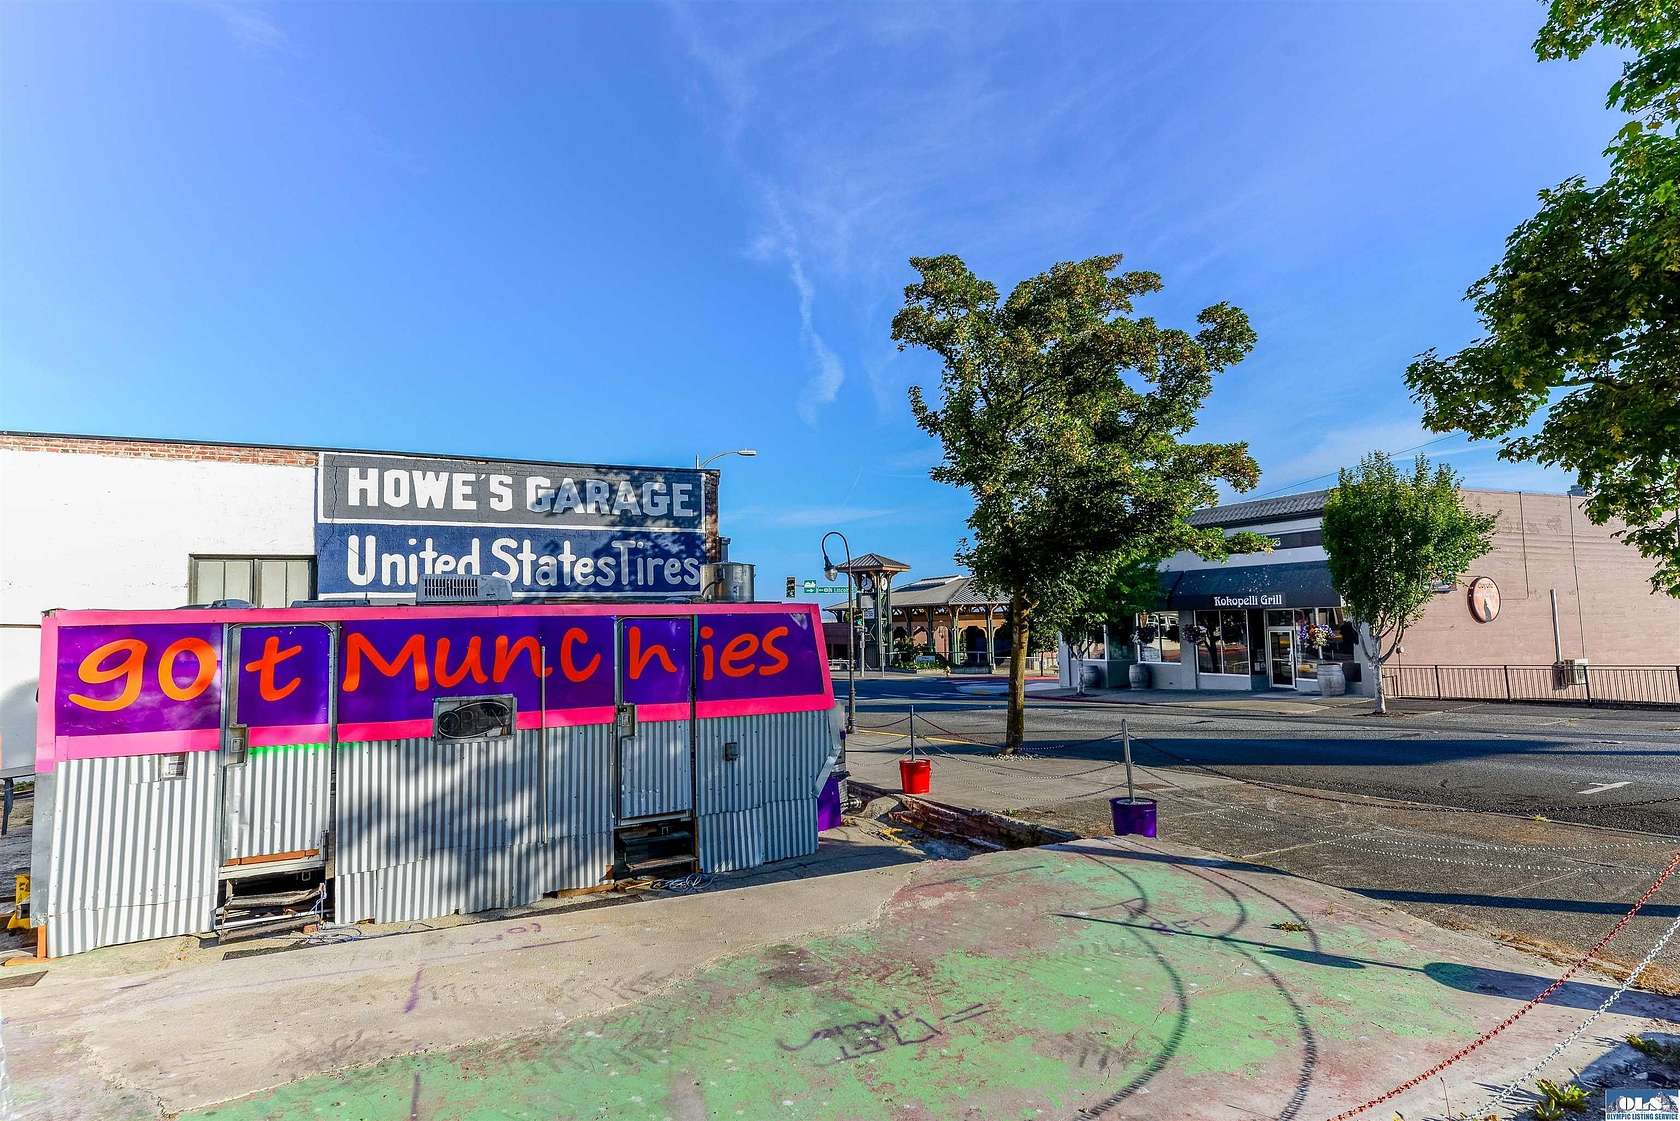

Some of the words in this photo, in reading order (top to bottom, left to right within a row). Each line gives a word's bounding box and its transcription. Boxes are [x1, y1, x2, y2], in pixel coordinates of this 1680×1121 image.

[347, 468, 513, 511] HOWE'S
[526, 476, 694, 517] GARAGE
[347, 534, 480, 587] United
[491, 536, 616, 587] States
[612, 540, 700, 587] Tires
[1213, 595, 1258, 608] Kokopelli
[1260, 594, 1282, 605] Grill
[68, 636, 303, 712] got
[342, 626, 789, 692] Munchies
